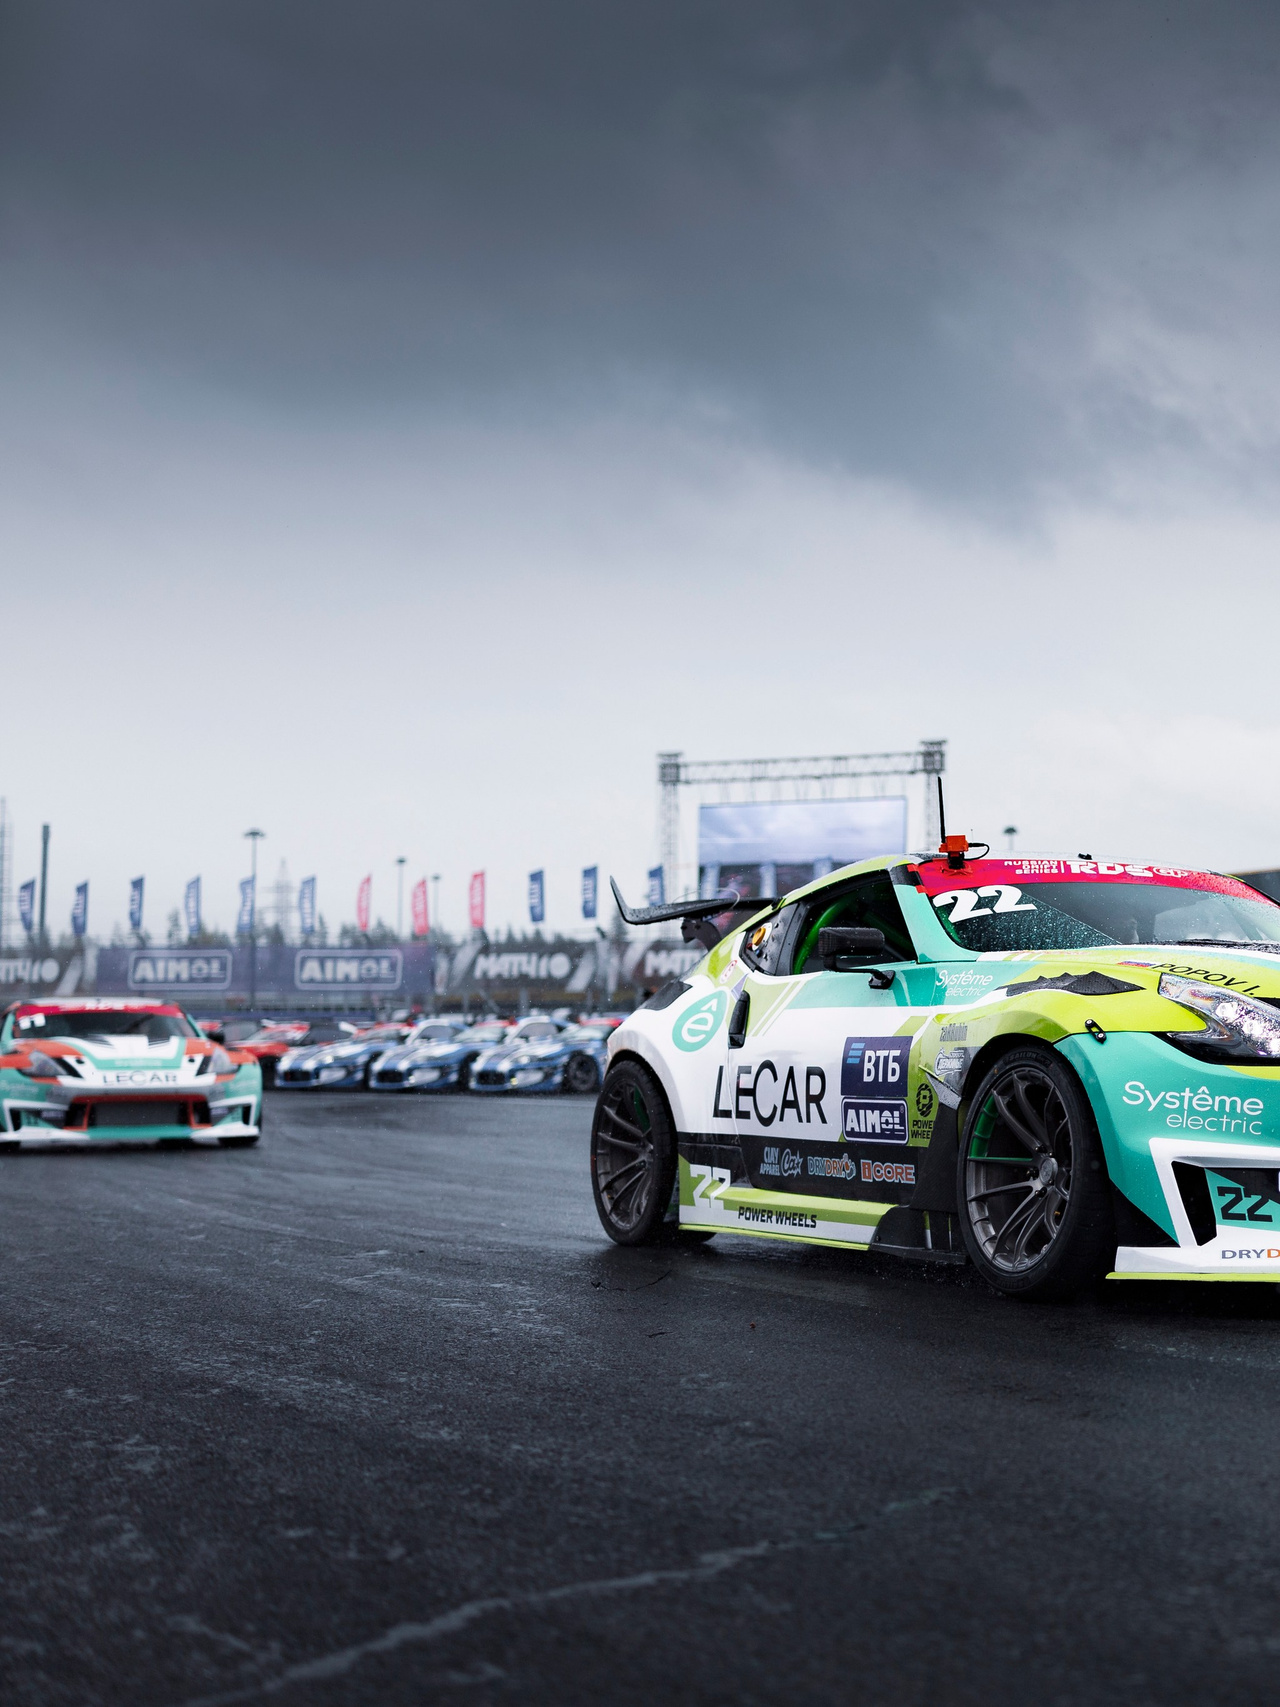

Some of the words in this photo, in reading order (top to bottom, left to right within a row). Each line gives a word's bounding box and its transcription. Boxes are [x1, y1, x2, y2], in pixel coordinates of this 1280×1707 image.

[1066, 860, 1154, 878] RDS
[933, 884, 1037, 924] 22
[133, 957, 225, 983] AIMOL
[301, 957, 395, 982] AIMOL
[935, 969, 994, 989] Systême
[1152, 963, 1248, 987] POPOV
[945, 986, 986, 997] electric
[103, 1070, 178, 1086] LECAR
[863, 1050, 902, 1082] ВТБ
[712, 1059, 828, 1128] LECAR
[1122, 1080, 1264, 1116] Systême
[845, 1108, 905, 1135] AIMOL
[1166, 1111, 1263, 1136] electric
[690, 1164, 731, 1210] 22
[1216, 1186, 1273, 1223] 22
[738, 1206, 773, 1225] POWER
[775, 1209, 817, 1229] WHEELS
